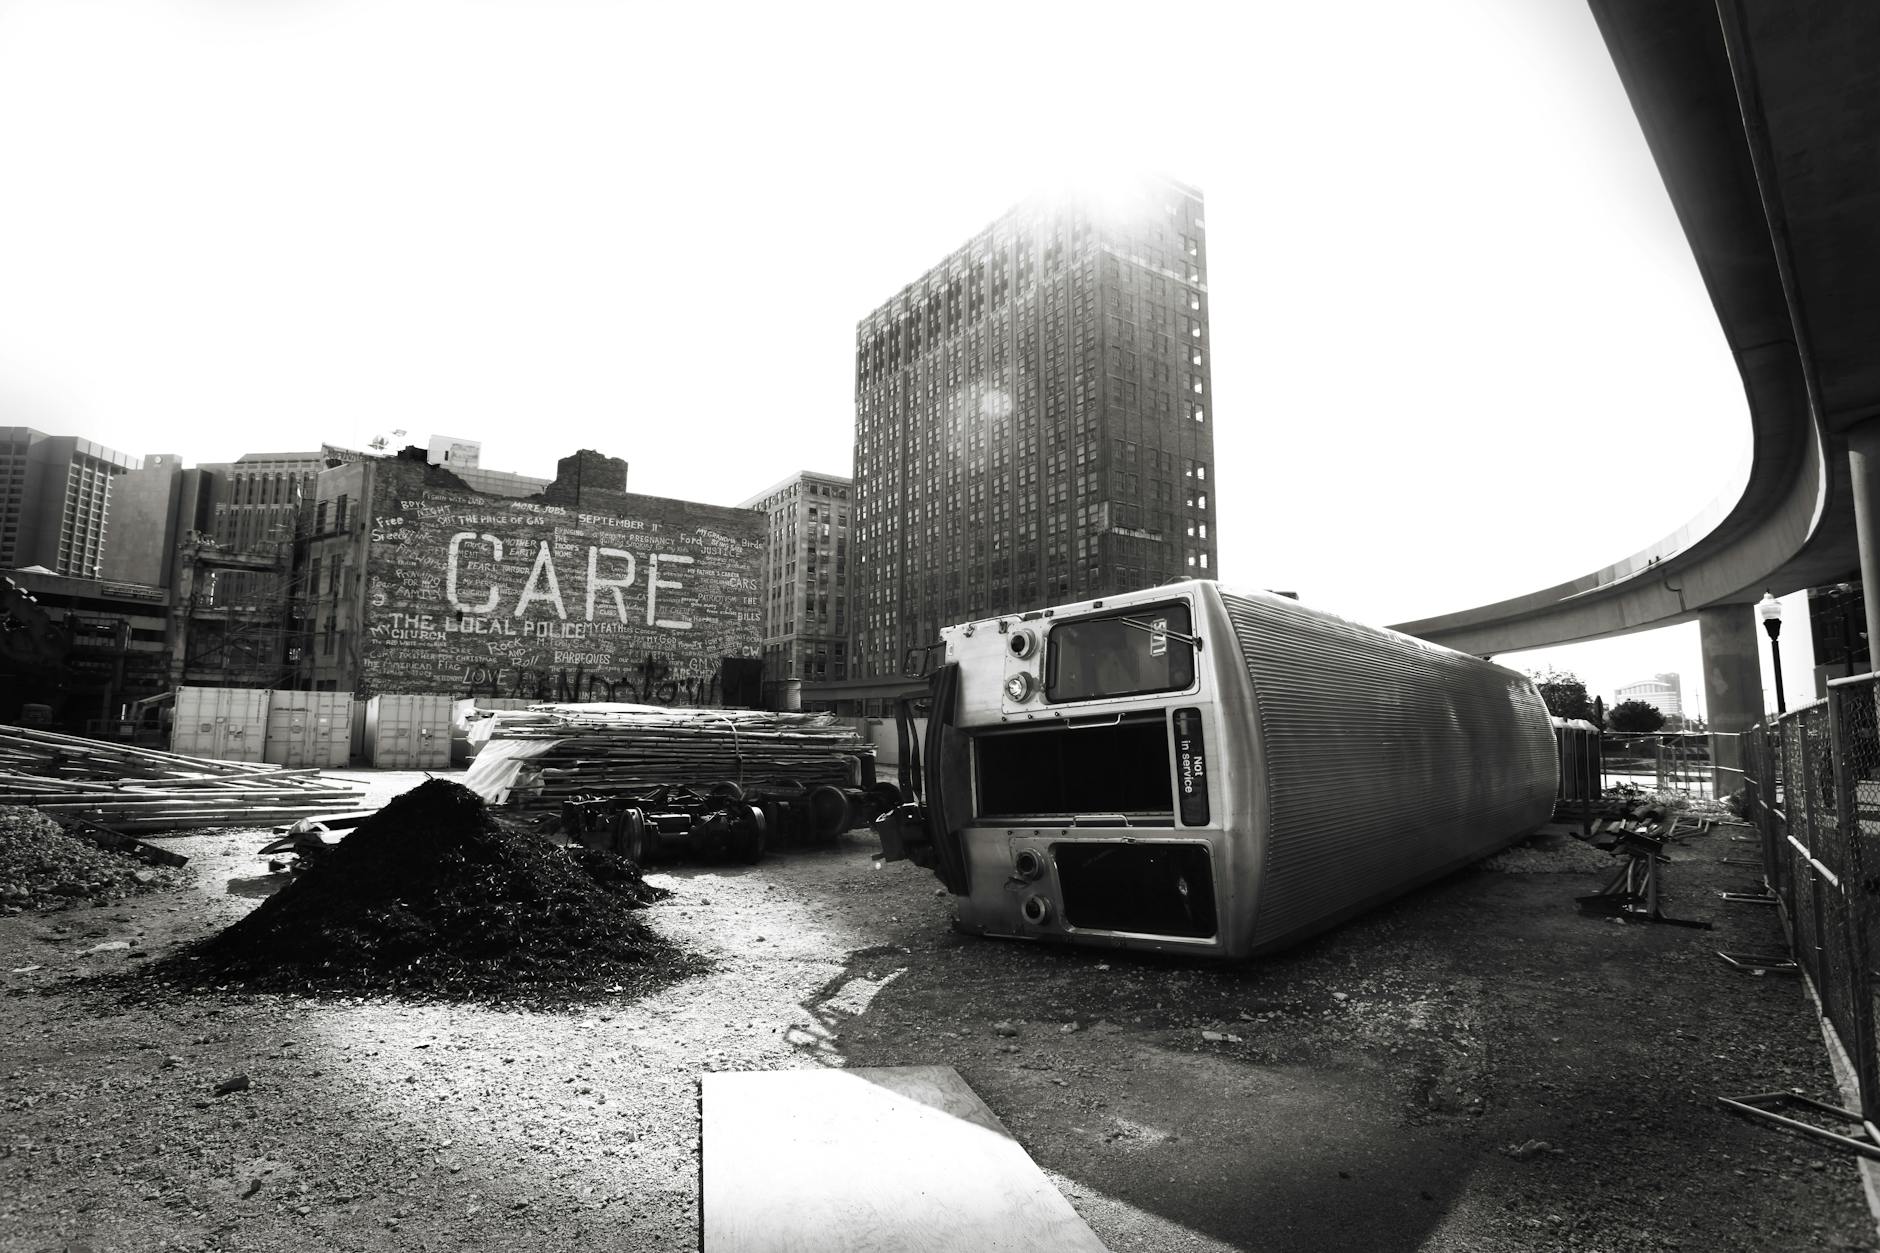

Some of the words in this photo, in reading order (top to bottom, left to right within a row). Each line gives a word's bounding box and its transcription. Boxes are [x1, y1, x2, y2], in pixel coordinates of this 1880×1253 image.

[417, 504, 452, 518] NIGHT
[511, 501, 541, 513] MORE
[542, 505, 567, 516] JOBS
[375, 515, 404, 528] Free
[458, 515, 478, 525] THE
[480, 515, 508, 524] PRICE
[510, 517, 524, 525] OF
[526, 517, 545, 525] GAS
[578, 513, 644, 530] SEPTEMBER
[695, 528, 707, 537] MY
[501, 537, 537, 549] MOTHER
[629, 534, 675, 546] PREGNANCY
[680, 533, 703, 547] Ford
[700, 546, 741, 559] JUSTICE
[446, 531, 695, 630] CARE
[729, 577, 758, 592] CARS
[743, 597, 757, 605] THE
[737, 612, 762, 622] BILLS
[368, 623, 391, 637] MY
[388, 613, 434, 631] THE
[445, 616, 517, 637] LOCAL
[524, 620, 587, 639] POLICE
[391, 628, 447, 641] CHURCH
[554, 650, 612, 665] BARBEQUES
[689, 657, 708, 671] GM
[462, 666, 510, 686] LOVE
[1181, 740, 1191, 750] in
[1182, 754, 1193, 793] service
[1193, 756, 1203, 777] Not
